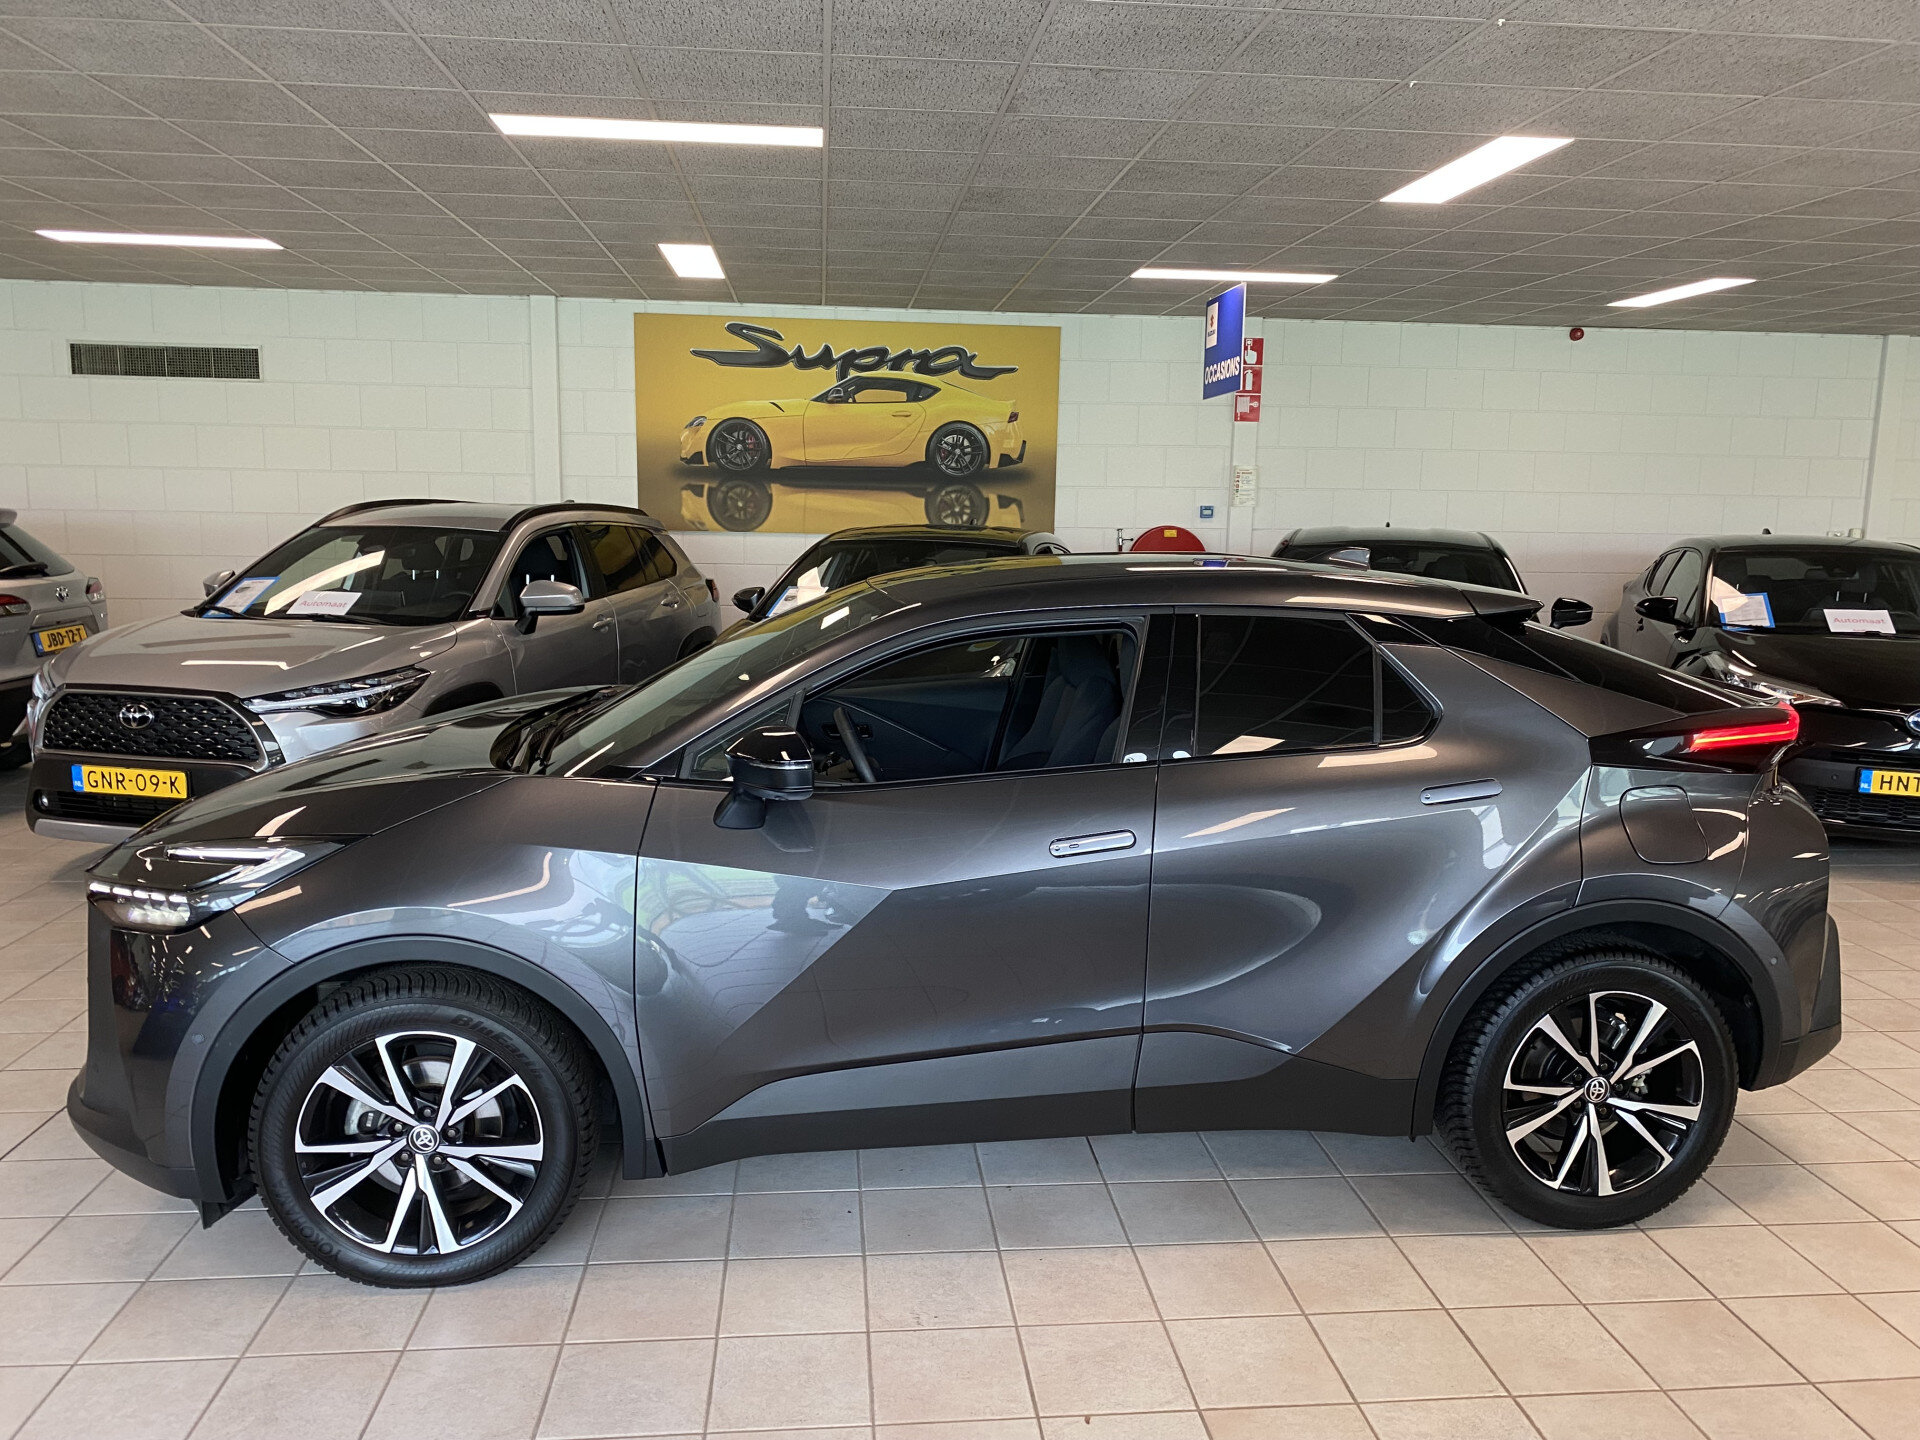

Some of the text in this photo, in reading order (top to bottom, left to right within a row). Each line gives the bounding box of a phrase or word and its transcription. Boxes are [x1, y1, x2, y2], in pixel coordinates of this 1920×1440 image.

[690, 321, 1018, 382] Supra
[1204, 356, 1241, 385] OCCASIONS
[301, 599, 347, 609] Automaat
[1833, 616, 1886, 625] Automaat
[47, 627, 83, 648] JBD-12-T
[87, 770, 181, 795] GNR-09-K
